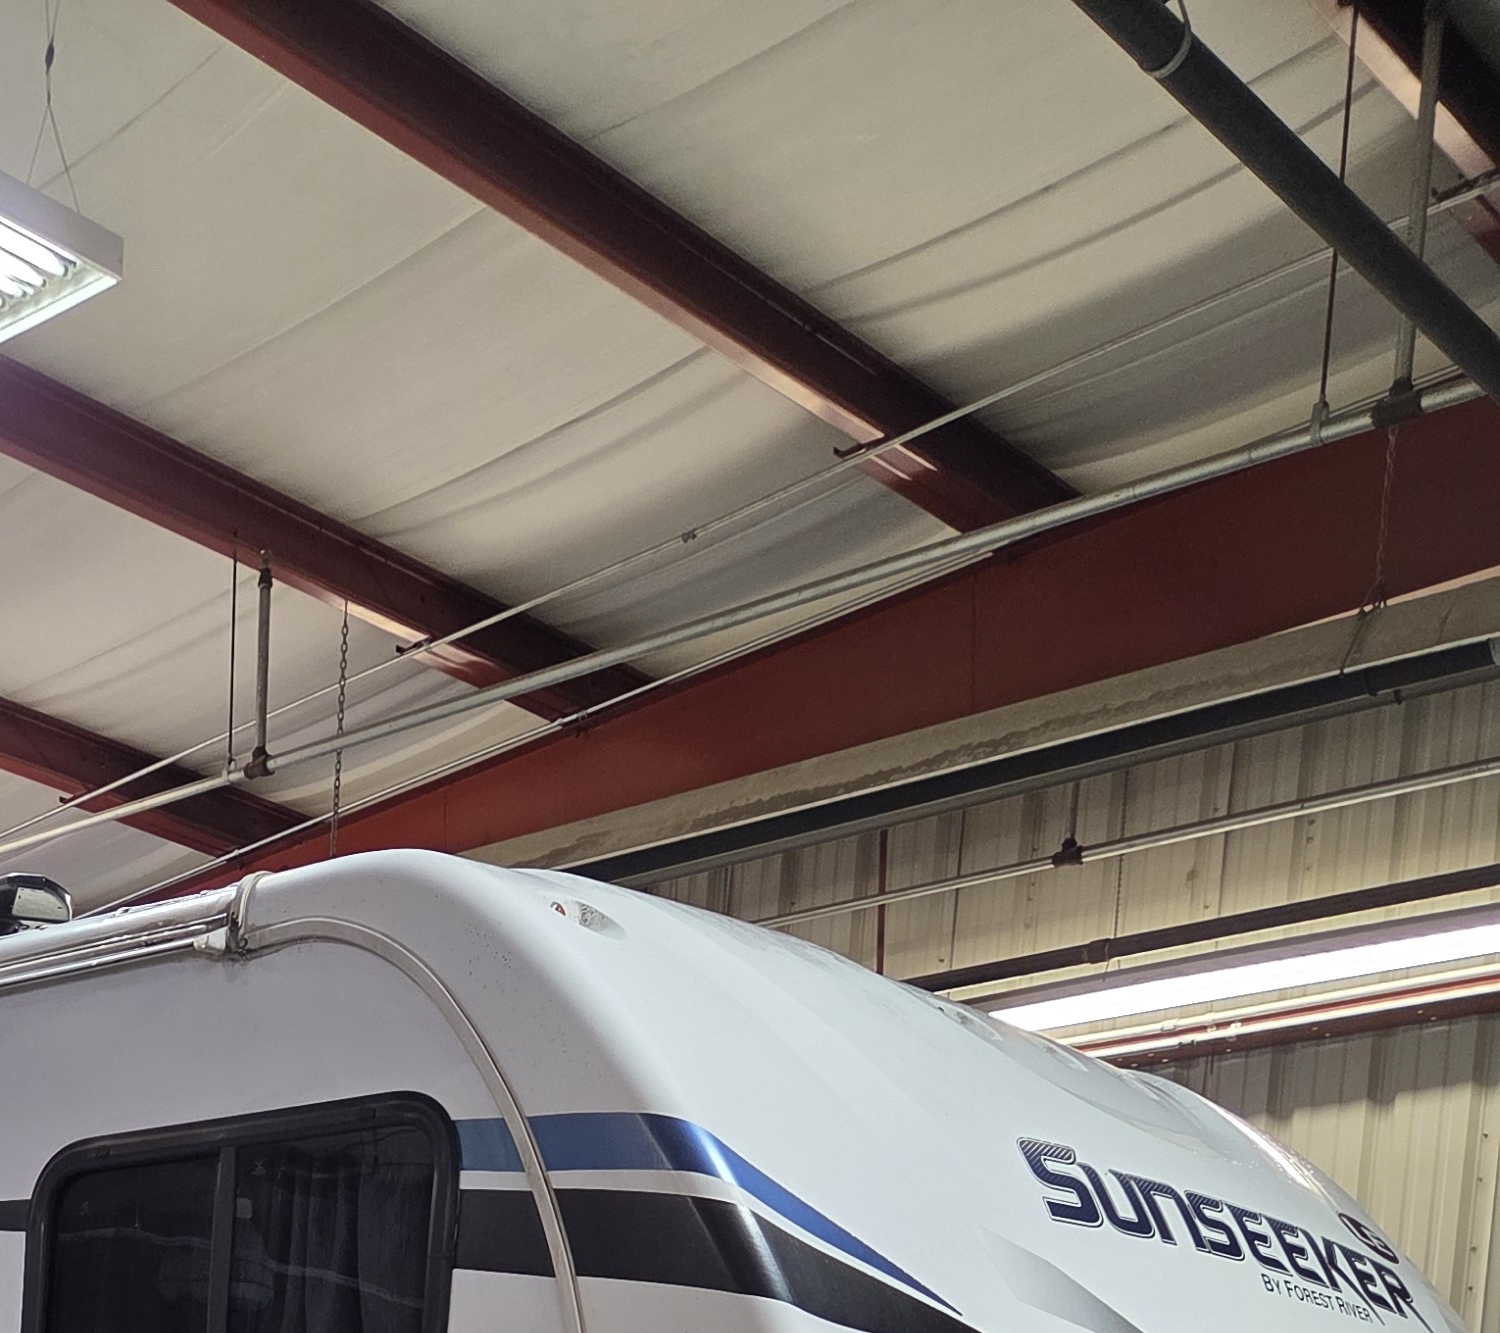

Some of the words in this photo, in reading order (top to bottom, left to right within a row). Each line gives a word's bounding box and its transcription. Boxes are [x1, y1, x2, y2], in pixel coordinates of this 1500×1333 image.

[1261, 1272, 1282, 1295] BY
[1284, 1280, 1335, 1311] FOREST
[1335, 1297, 1374, 1325] RIVER
